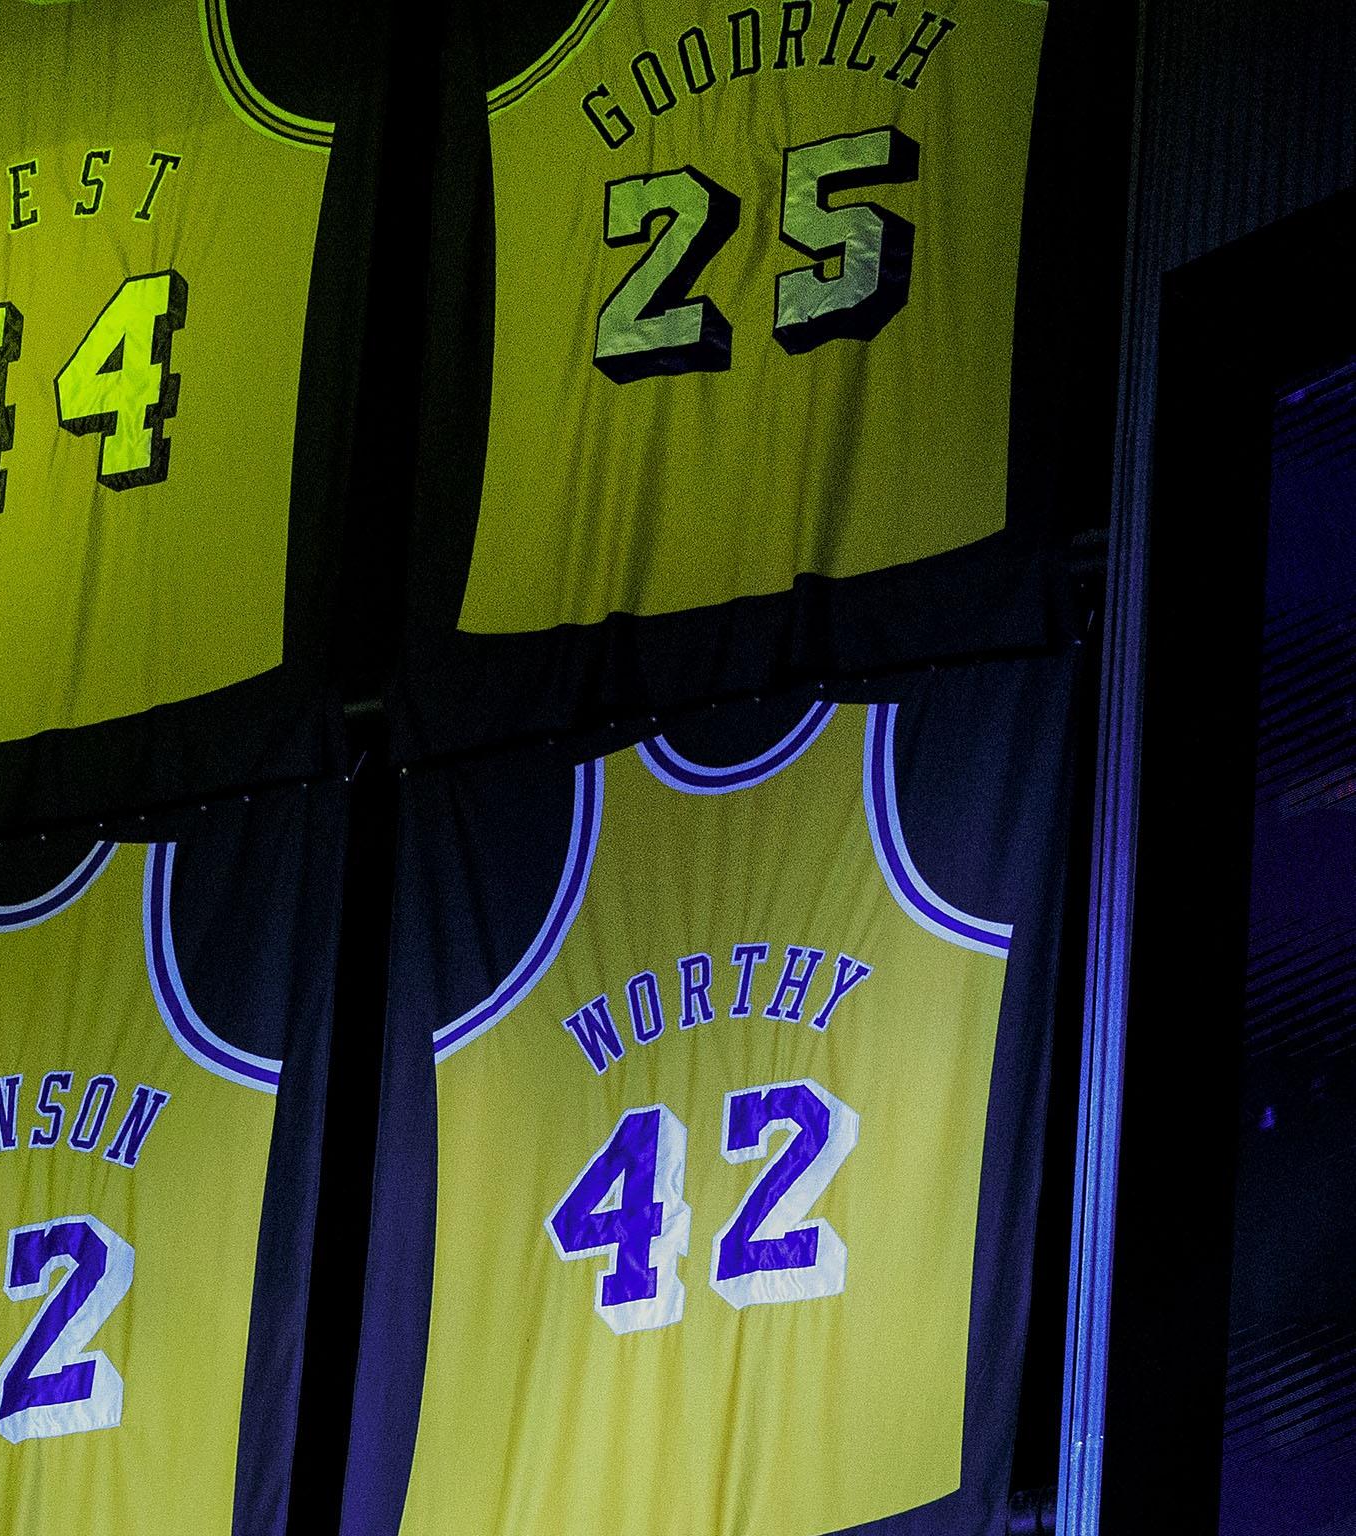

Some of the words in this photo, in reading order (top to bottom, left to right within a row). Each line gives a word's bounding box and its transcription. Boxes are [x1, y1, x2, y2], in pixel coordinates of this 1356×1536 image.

[582, 0, 956, 149] GOODRICH
[593, 125, 920, 384] 25
[561, 941, 874, 1076] WORTHY
[543, 1078, 860, 1336] 42
